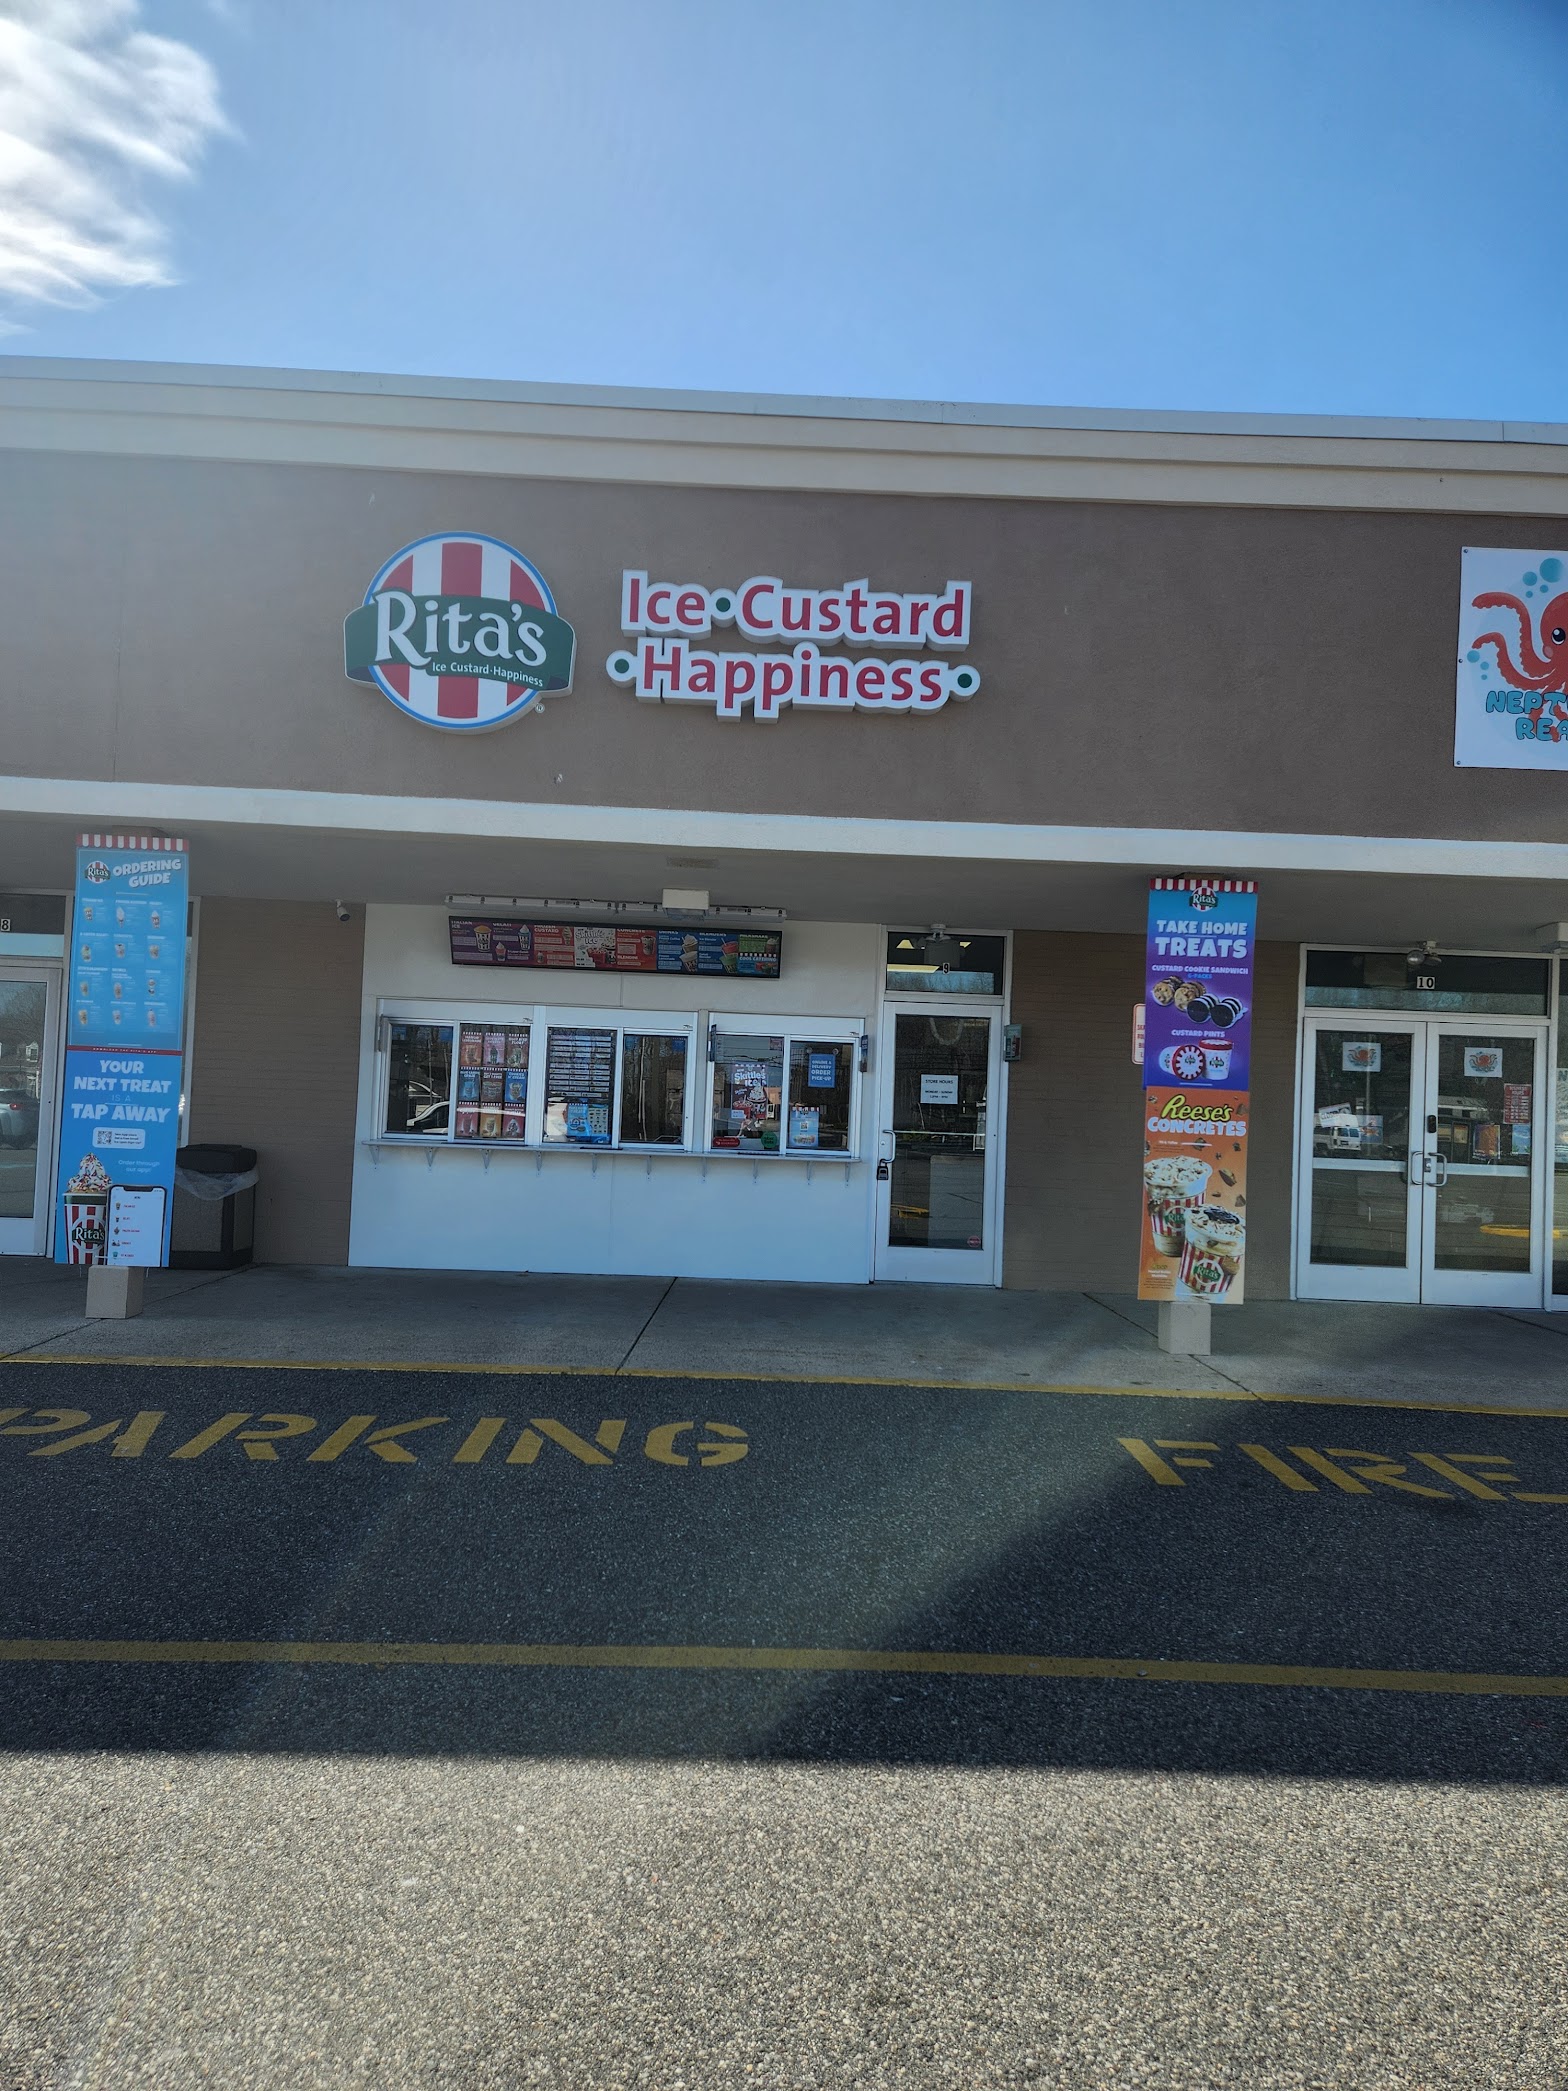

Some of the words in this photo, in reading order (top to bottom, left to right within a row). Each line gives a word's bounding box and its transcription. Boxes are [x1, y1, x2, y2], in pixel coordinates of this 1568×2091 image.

[629, 578, 705, 626] Ice
[742, 584, 965, 637] Custard
[375, 591, 547, 667] Rita's
[432, 662, 447, 672] Ice
[643, 645, 941, 711] Happiness
[1486, 691, 1568, 716] NEPT
[88, 868, 109, 877] Rita's
[113, 859, 181, 876] ORDERING
[129, 872, 170, 888] GUIDE
[1193, 893, 1216, 905] Rita's
[1, 919, 9, 931] 8
[1156, 920, 1199, 934] TAKE
[1201, 921, 1248, 936] HOME
[1155, 937, 1248, 959] TREATS
[1152, 964, 1183, 973] CUSTARD
[1184, 965, 1210, 973] COOKIE
[1210, 966, 1249, 975] SANDWICH
[1419, 977, 1434, 989] 10
[1171, 1029, 1203, 1037] CUSTARD
[1203, 1030, 1226, 1038] PINTS
[100, 1060, 144, 1074] YOUR
[74, 1076, 117, 1091] NEXT
[120, 1078, 172, 1093] TREAT
[112, 1094, 121, 1102] IS
[71, 1103, 109, 1120] TAP
[112, 1105, 171, 1123] AWAY
[1160, 1093, 1234, 1123] Reese's
[1147, 1116, 1247, 1137] CONCRETES
[1197, 1266, 1219, 1280] Rita's
[0, 1408, 749, 1467] PARKING
[1117, 1437, 1568, 1504] FIRE
